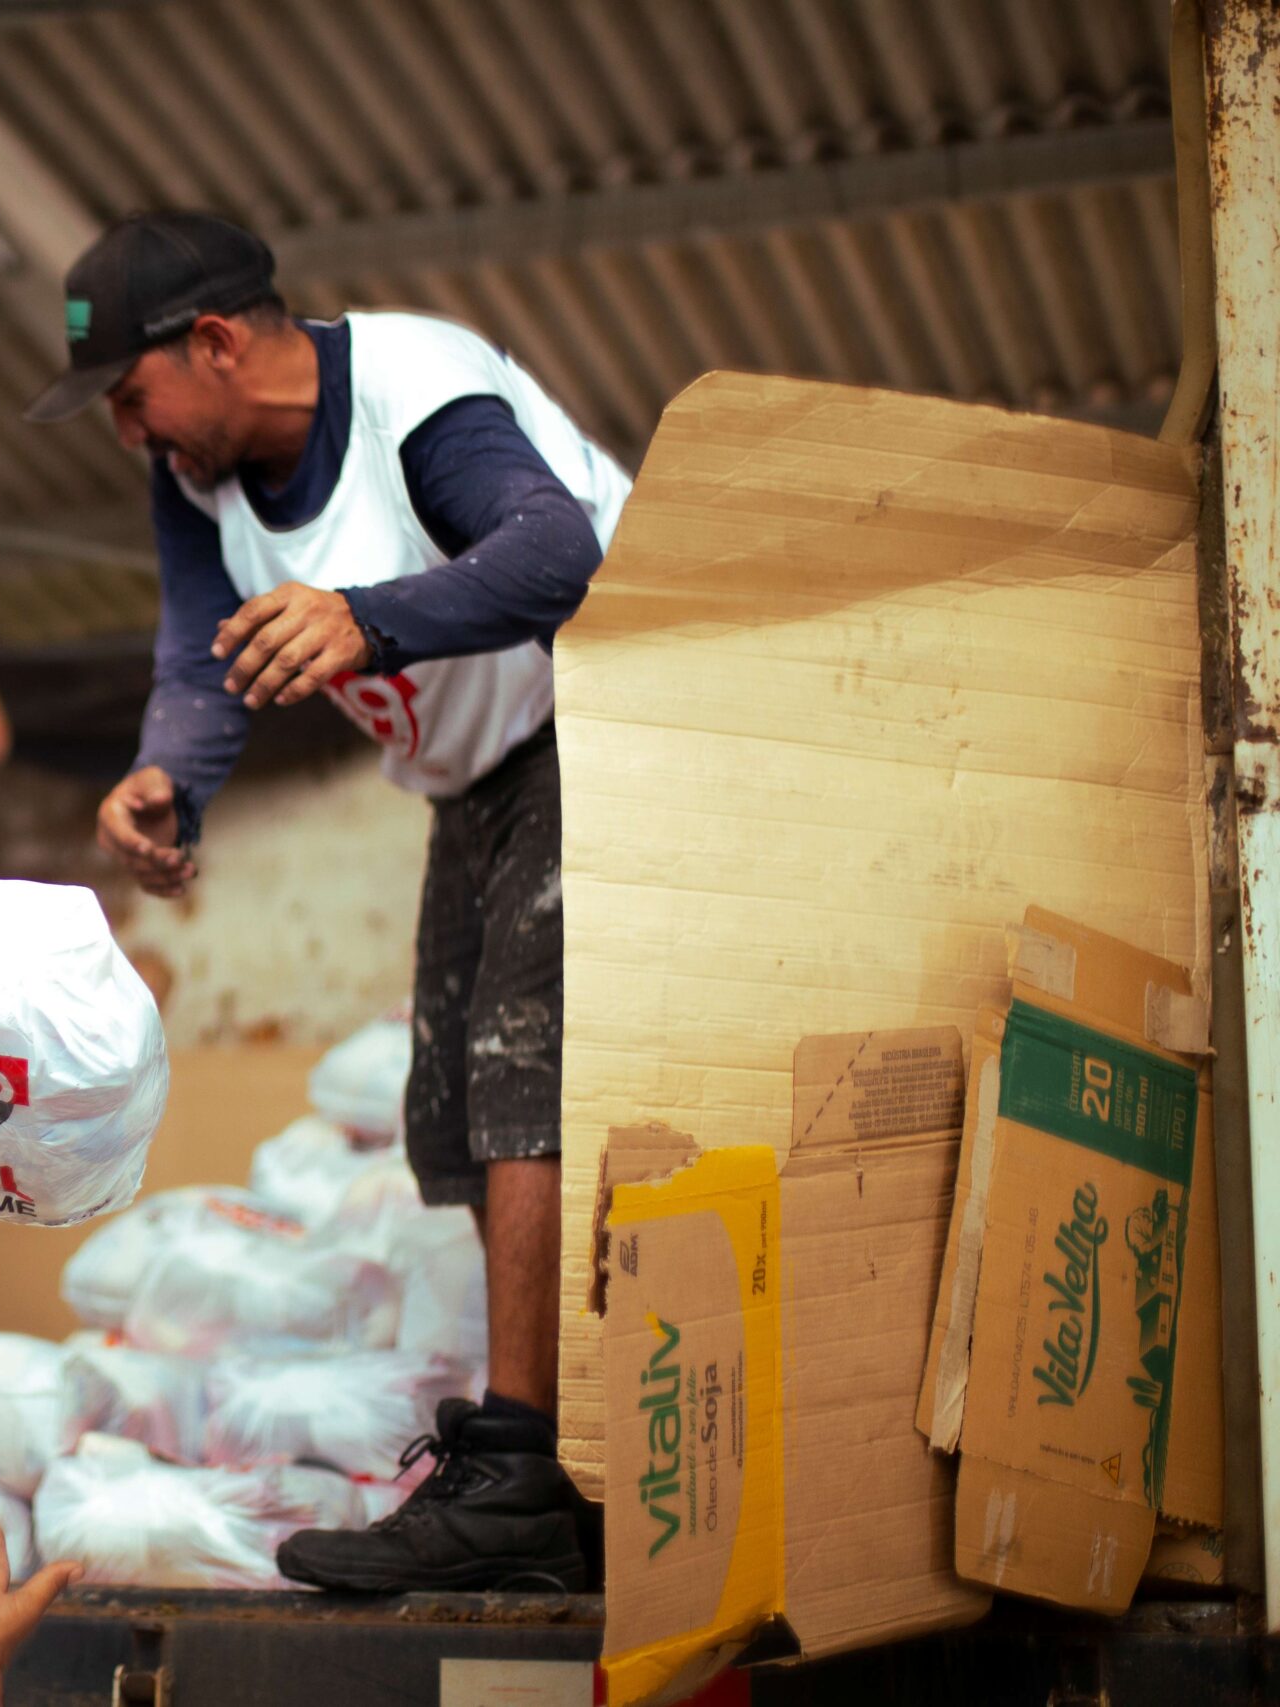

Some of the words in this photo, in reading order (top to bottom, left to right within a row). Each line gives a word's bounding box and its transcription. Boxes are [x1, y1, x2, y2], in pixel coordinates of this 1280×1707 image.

[1082, 1057, 1112, 1121] 20
[1136, 1103, 1146, 1137] 900
[1171, 1109, 1186, 1150] TIPO
[630, 1233, 638, 1277] ADM
[700, 1361, 722, 1444] Soja
[639, 1312, 681, 1560] vitaliv
[706, 1446, 717, 1467] de
[704, 1477, 718, 1532] Óleo
